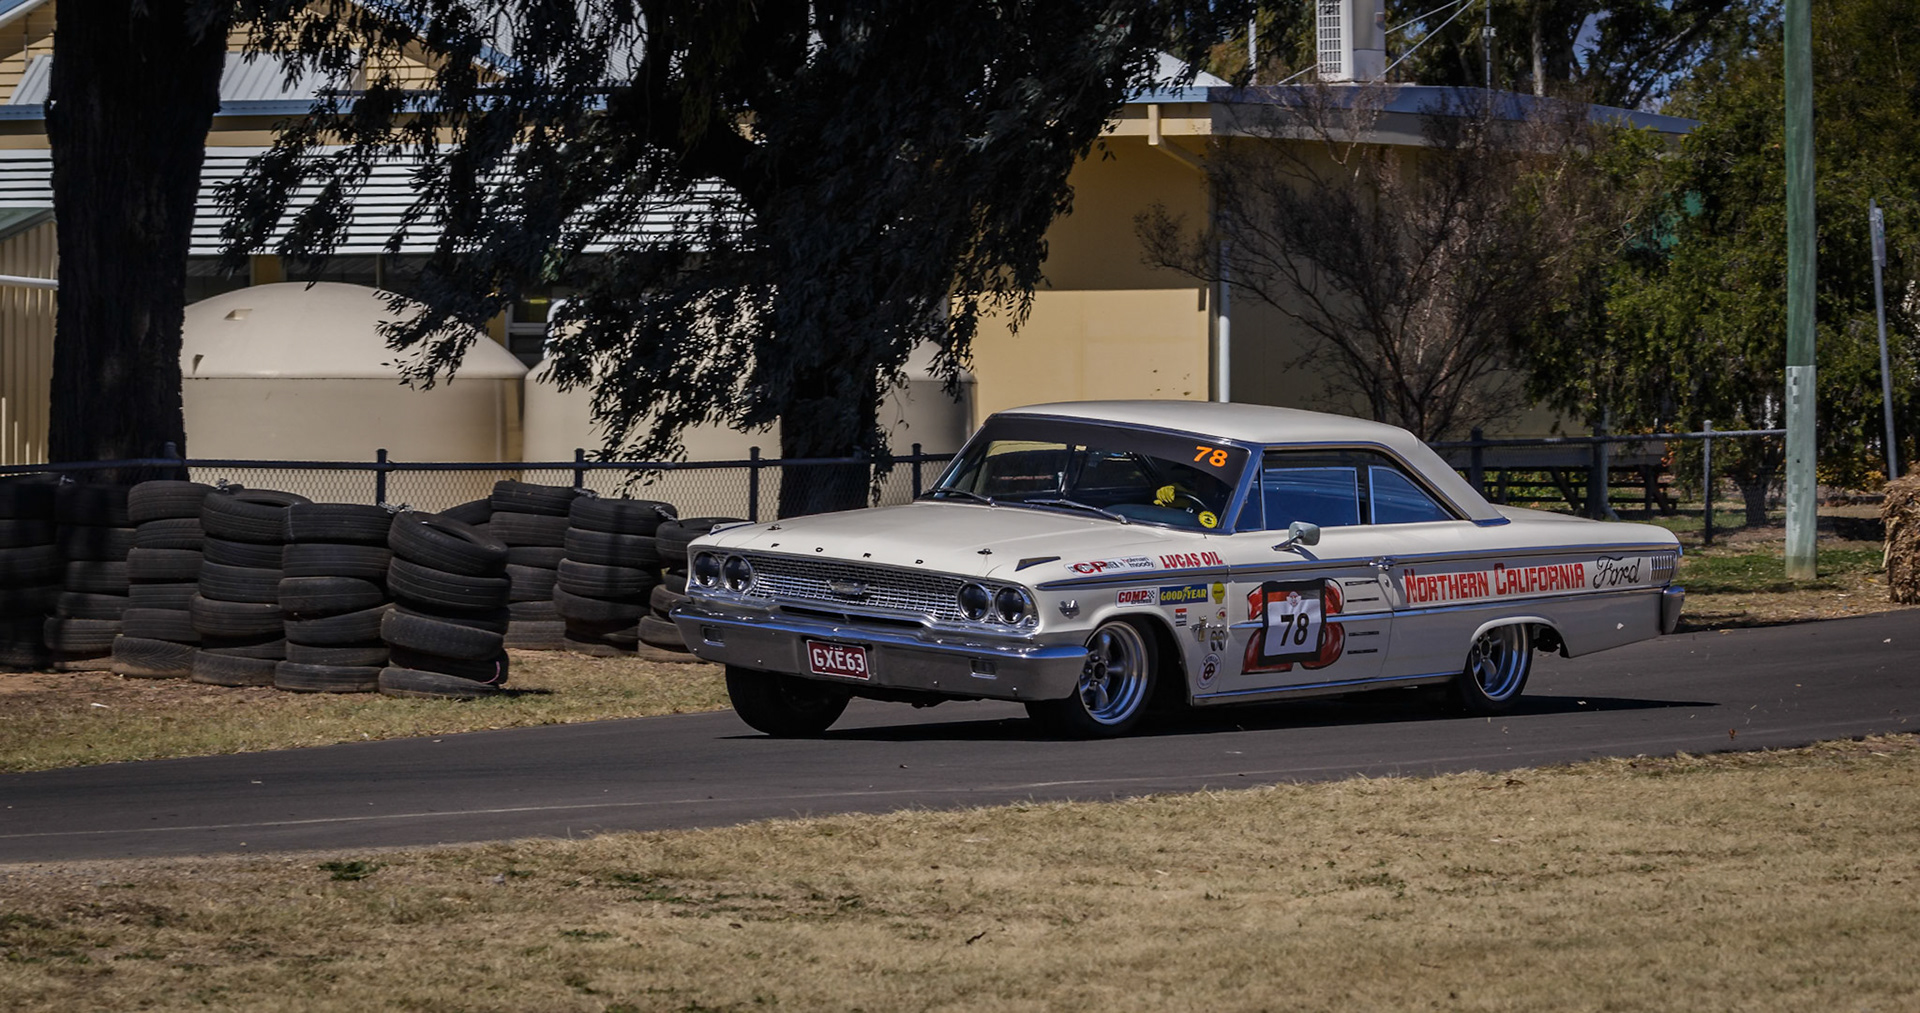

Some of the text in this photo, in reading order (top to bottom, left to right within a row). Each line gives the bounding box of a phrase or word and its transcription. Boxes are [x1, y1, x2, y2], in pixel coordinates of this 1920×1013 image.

[1193, 446, 1228, 467] 78
[1158, 551, 1223, 568] LUCAS OIL
[1404, 556, 1641, 604] NORTHERN CALIFORNIA Ford
[1118, 590, 1148, 603] COMP
[1161, 587, 1207, 602] GOODYEAR
[1280, 613, 1310, 647] 78
[813, 648, 865, 672] GXE63
